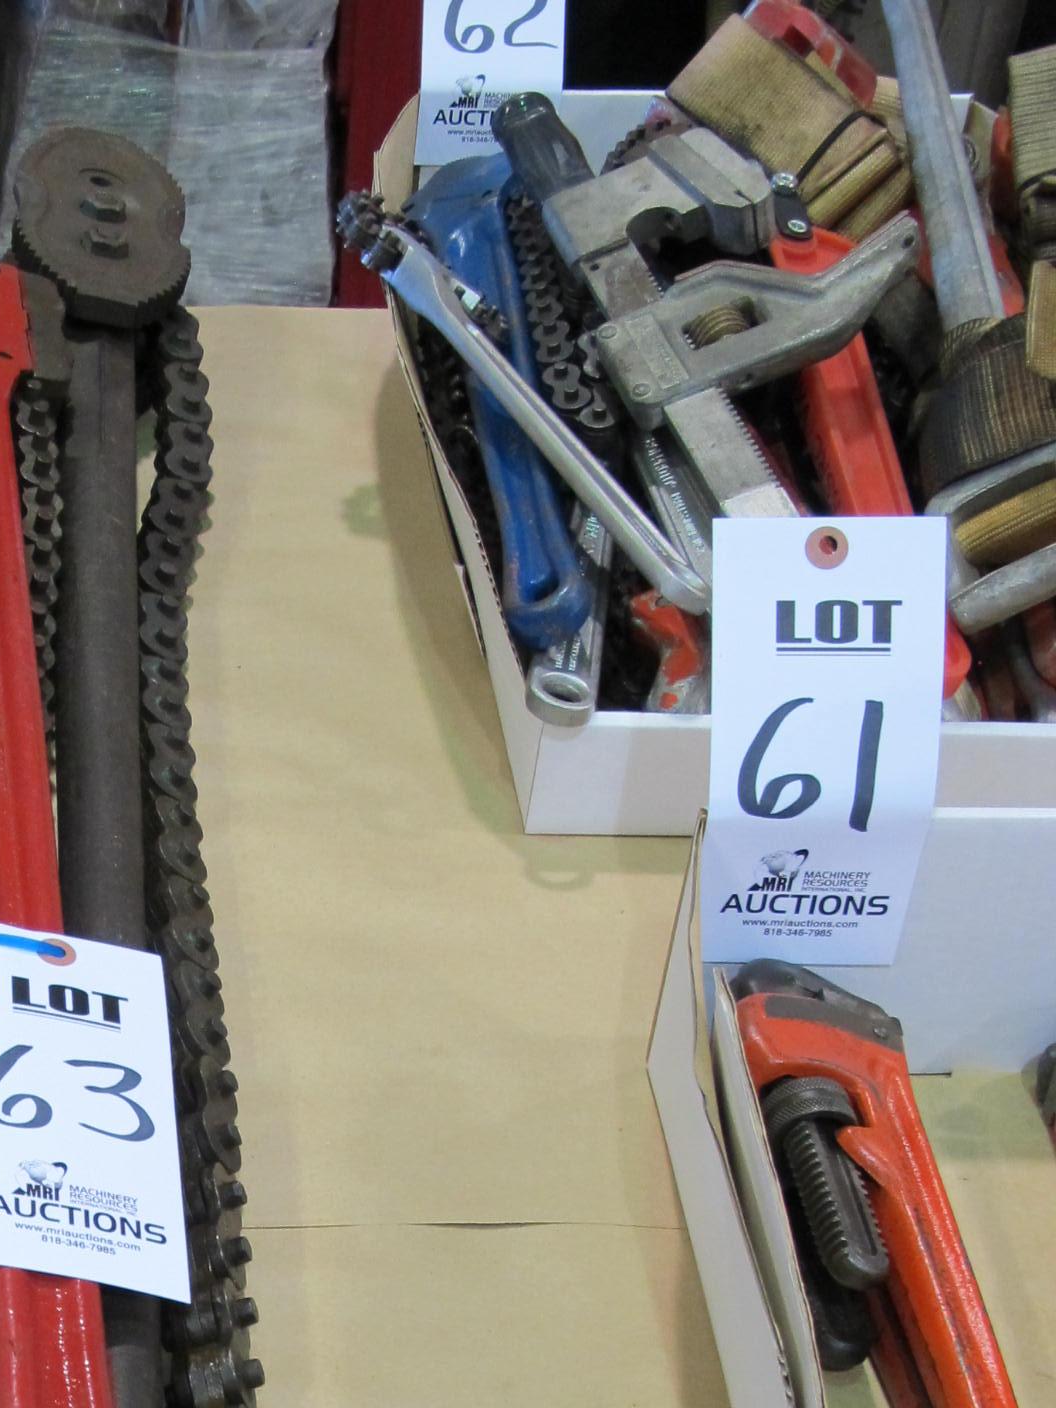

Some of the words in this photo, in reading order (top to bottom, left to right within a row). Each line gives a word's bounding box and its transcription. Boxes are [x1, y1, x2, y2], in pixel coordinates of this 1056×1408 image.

[444, 0, 558, 53] 62
[458, 96, 480, 108] MRI
[433, 109, 495, 126] AUCTI
[776, 599, 903, 644] LOT
[737, 697, 884, 832] 61
[761, 877, 796, 892] MRI
[802, 879, 869, 887] RESOURCES
[804, 871, 872, 880] MACHINERY
[720, 893, 891, 916] AUCTIONS
[742, 918, 859, 928] www.mriauctions.com
[763, 928, 833, 937] 818-346-7985
[11, 975, 129, 1024] LOT
[26, 1183, 61, 1201] MRI
[69, 1184, 138, 1204] MACHINERY
[69, 1192, 139, 1213] RESOURCES
[14, 1221, 142, 1252] www.mriauctions.com
[41, 1234, 117, 1256] 818-346-7985
